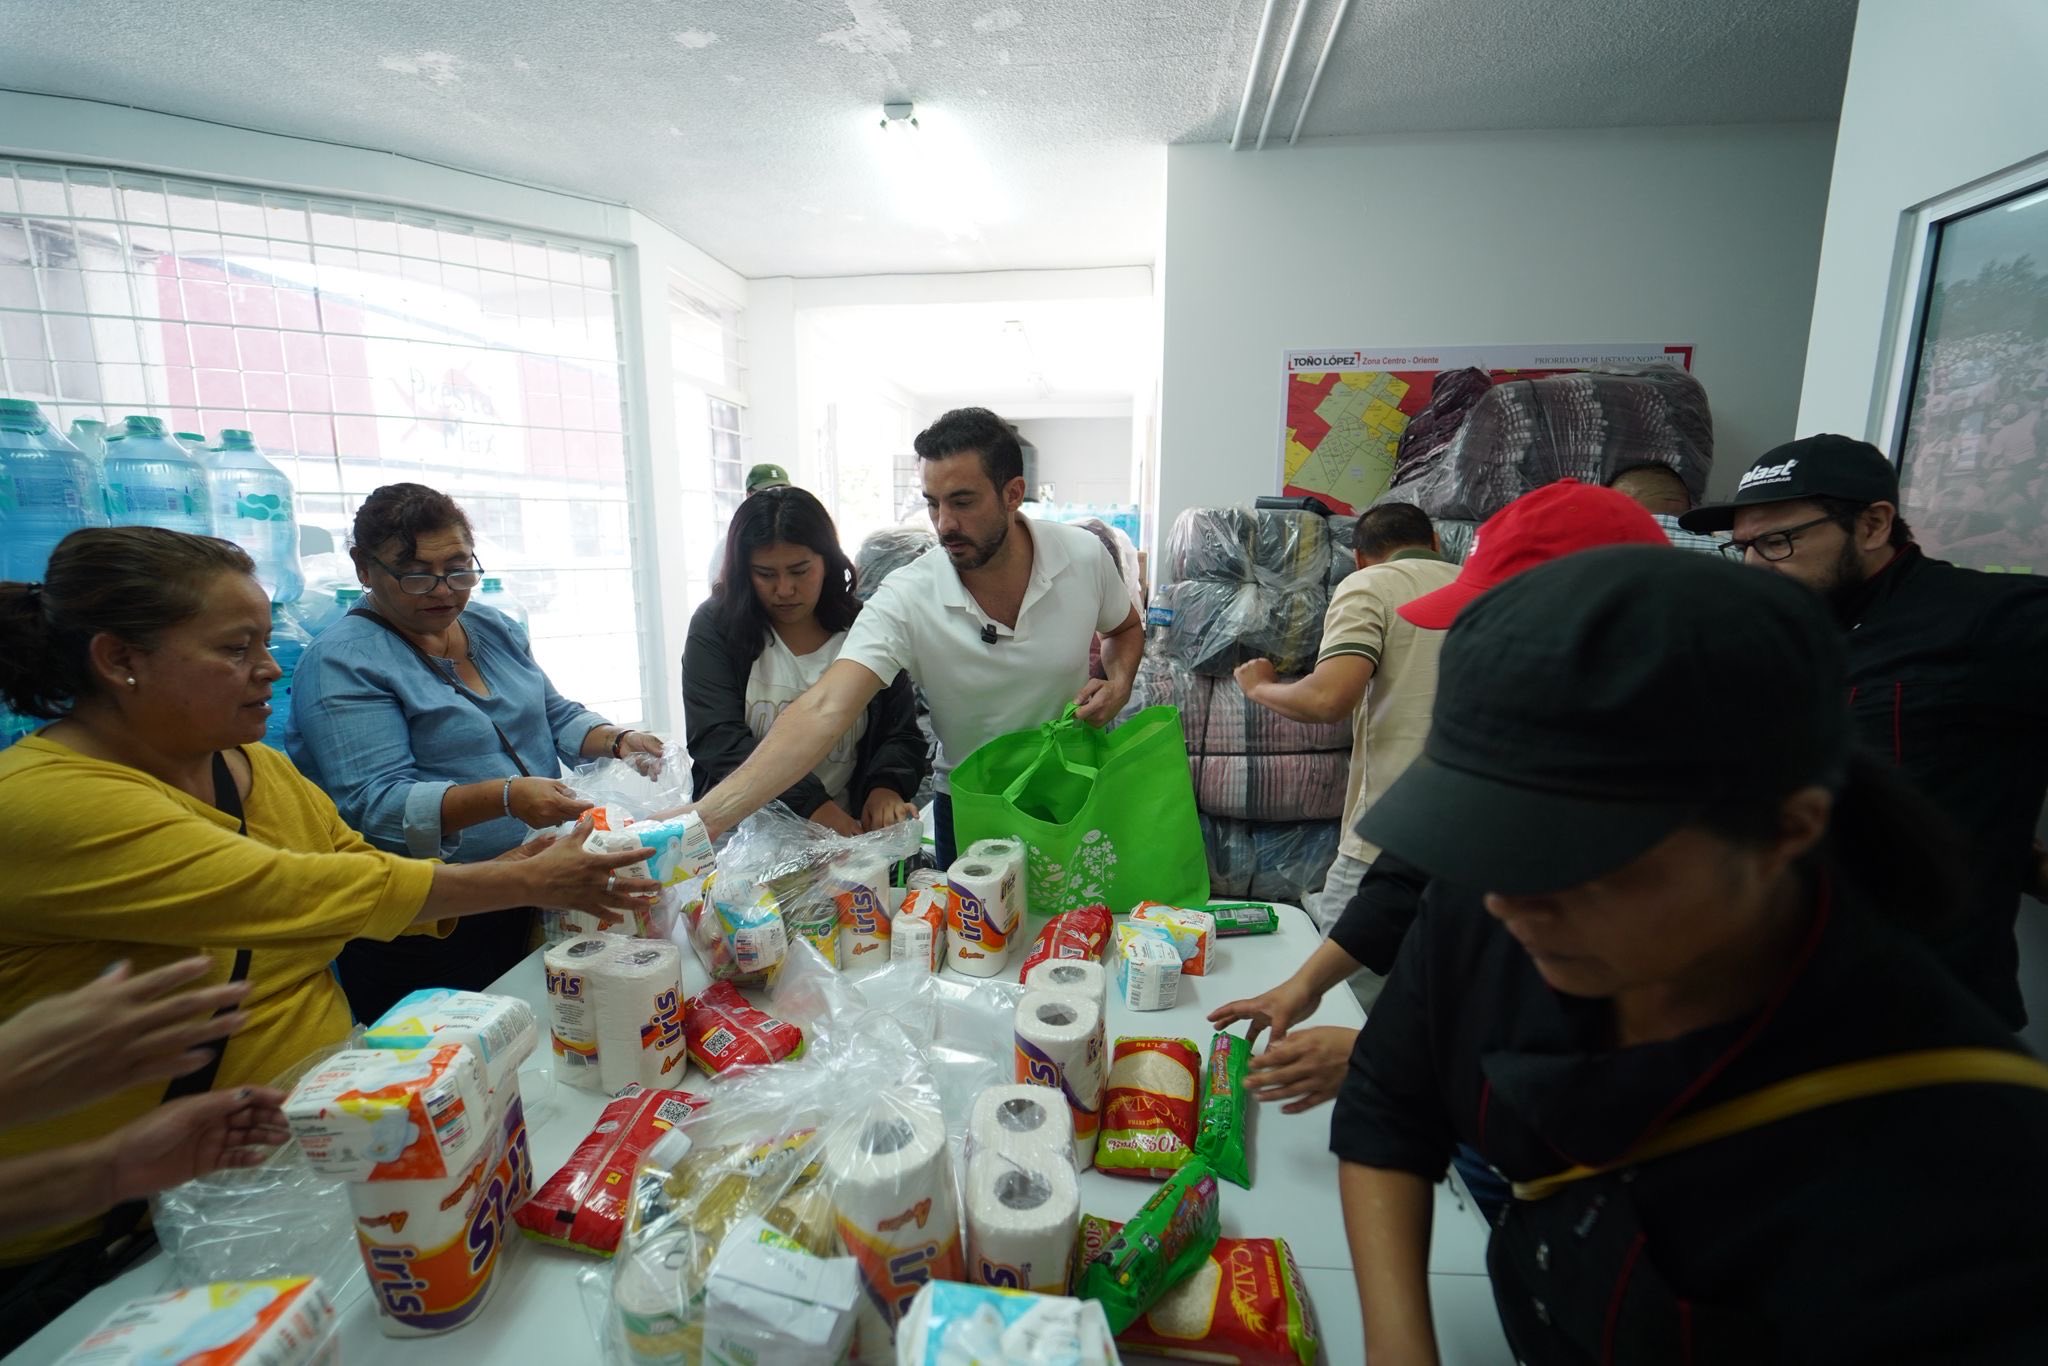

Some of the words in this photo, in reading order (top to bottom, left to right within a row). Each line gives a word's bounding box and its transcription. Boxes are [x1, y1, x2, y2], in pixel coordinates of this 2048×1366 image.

[1294, 355, 1322, 366] TOÑO
[1324, 355, 1355, 366] LÓPEZ
[1362, 357, 1380, 365] Zona
[1383, 357, 1406, 365] Centro
[1413, 356, 1439, 364] Oriente
[1535, 357, 1580, 365] PRIORIDAD
[1581, 356, 1597, 364] POR
[850, 892, 876, 933] iris
[958, 898, 981, 942] iris
[545, 968, 581, 996] iris
[653, 990, 680, 1048] iris
[468, 1128, 532, 1273] iris
[370, 1248, 427, 1314] iris
